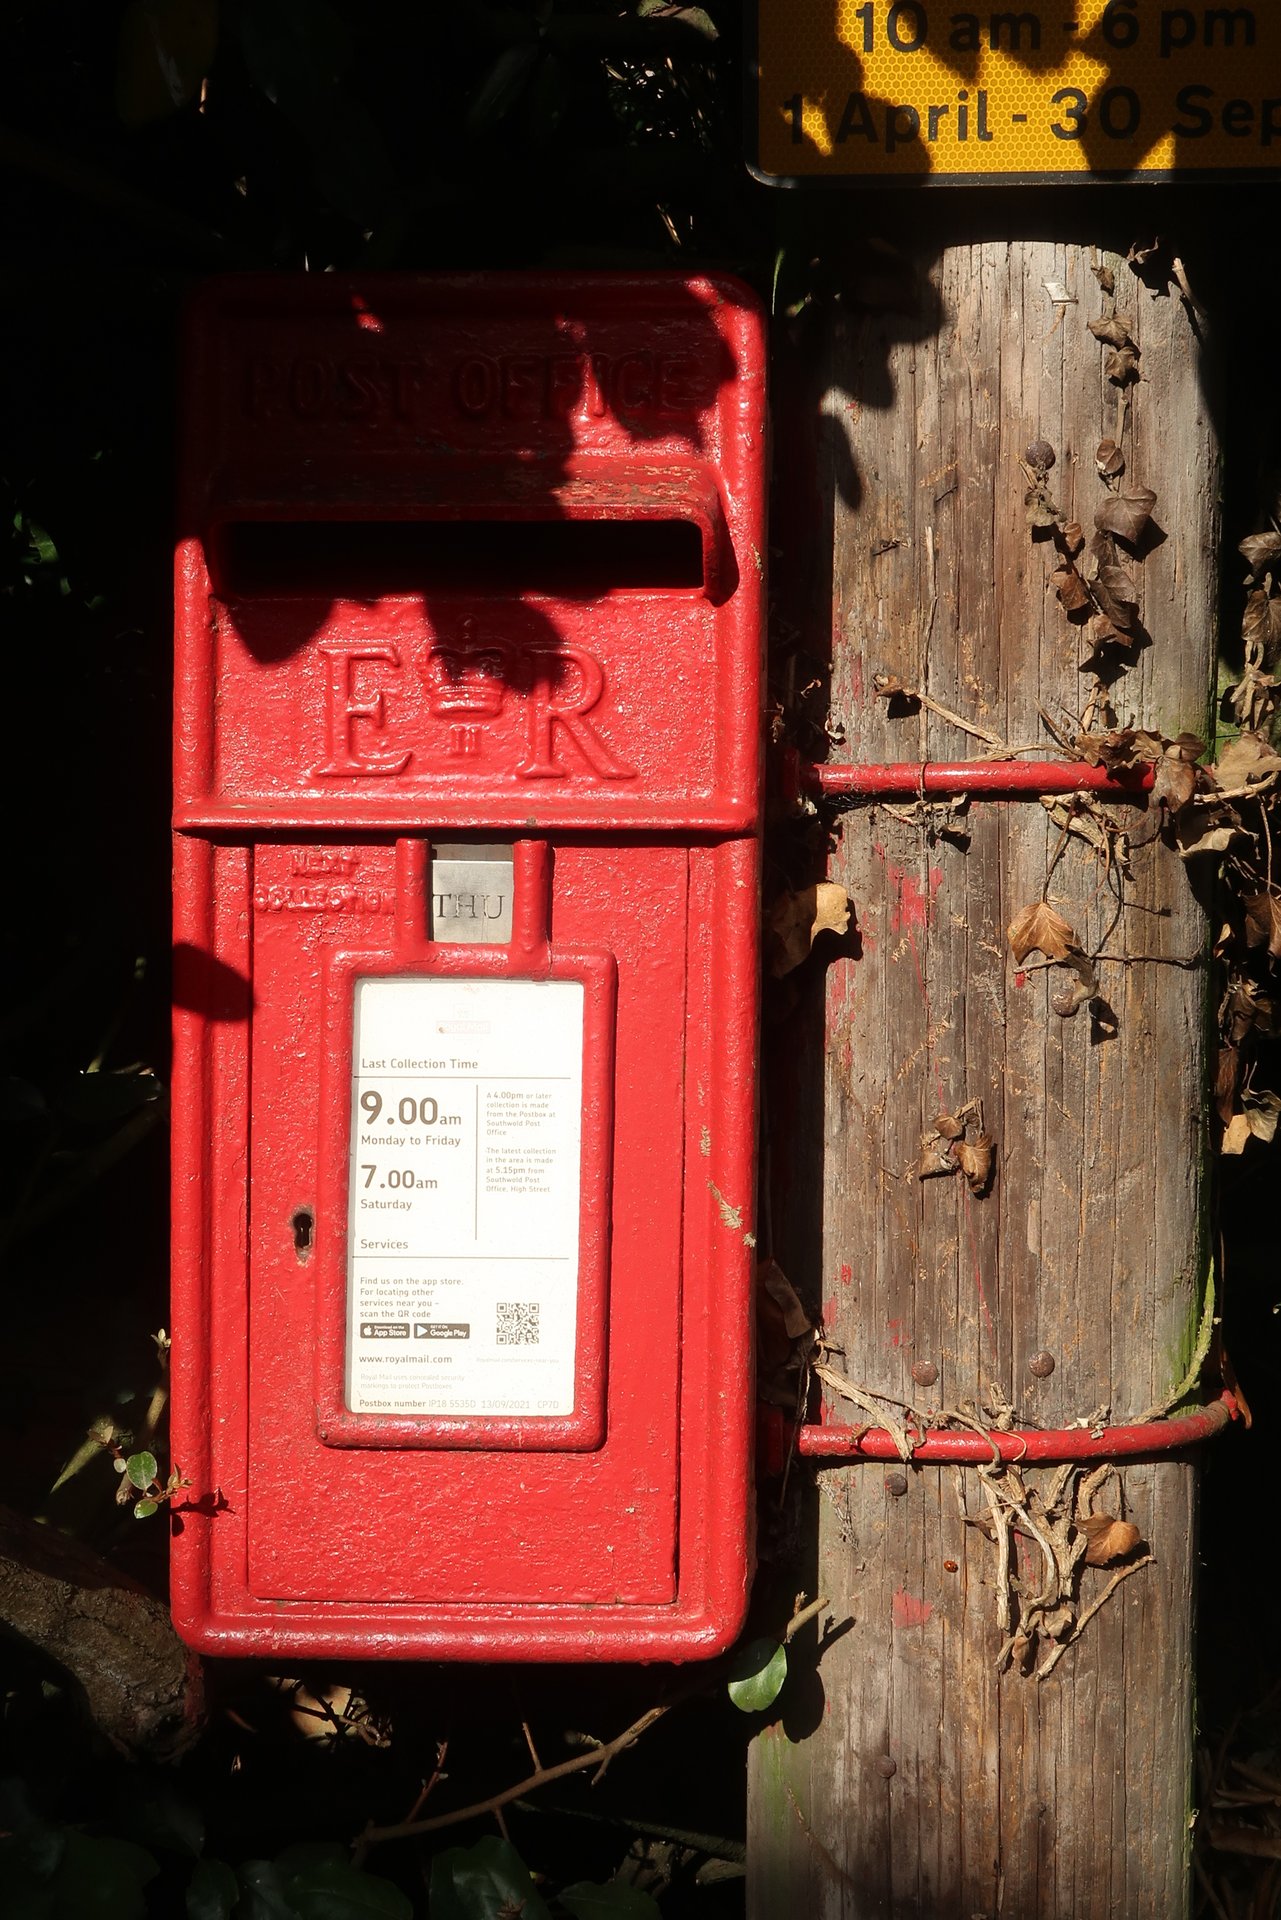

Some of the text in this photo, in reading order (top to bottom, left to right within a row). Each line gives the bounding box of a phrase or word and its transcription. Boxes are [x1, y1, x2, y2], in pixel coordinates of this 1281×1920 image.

[856, 1, 928, 53] 10
[949, 9, 1041, 50] am
[1102, 0, 1140, 48] 6
[1161, 7, 1257, 58] pm
[782, 93, 803, 144] 1
[834, 89, 993, 154] April
[1050, 86, 1141, 140] 30
[244, 350, 701, 420] POST OFFICE
[314, 638, 413, 777] E
[516, 638, 637, 780] R
[432, 893, 506, 920] THU
[362, 1058, 478, 1070] Last Collection Time
[494, 1091, 523, 1100] 4.00pm
[360, 1090, 462, 1125] 9.00am
[361, 1135, 460, 1147] Monday to Friday
[361, 1164, 438, 1188] 7.00am
[496, 1166, 525, 1174] 5.15pm
[361, 1199, 412, 1211] Saturday
[361, 1239, 408, 1249] Services
[376, 1288, 409, 1297] locating
[359, 1355, 452, 1365] www.royalmail.com
[480, 1400, 530, 1409] 13/09/2021
